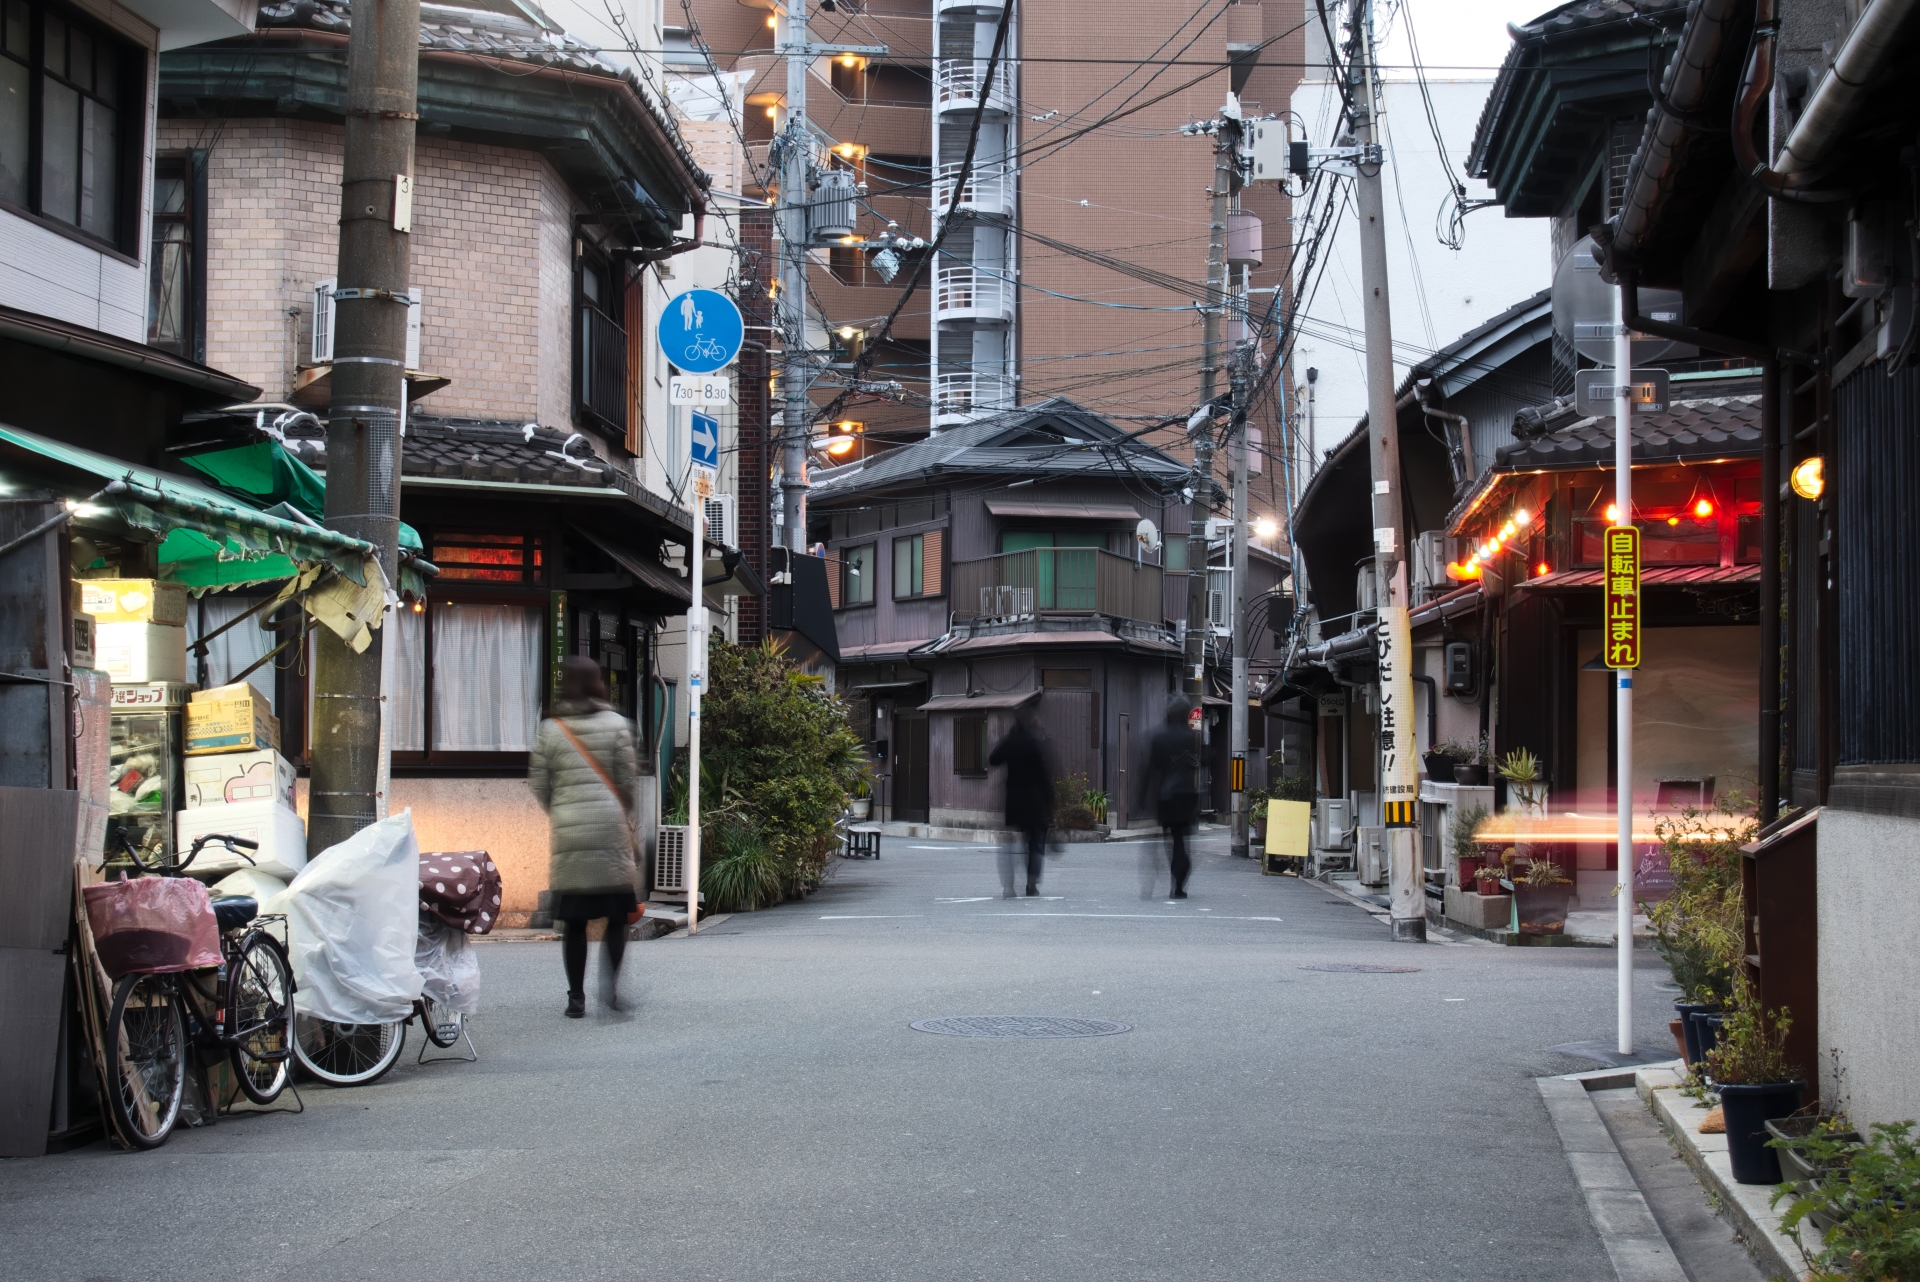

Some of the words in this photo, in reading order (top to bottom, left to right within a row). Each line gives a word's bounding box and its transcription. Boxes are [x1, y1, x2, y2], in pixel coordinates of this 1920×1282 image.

[693, 481, 715, 497] ここから
[1610, 532, 1635, 663] 自転車止まれ
[1377, 616, 1396, 773] とびだし注意!!
[1383, 784, 1414, 795] 市建設局
